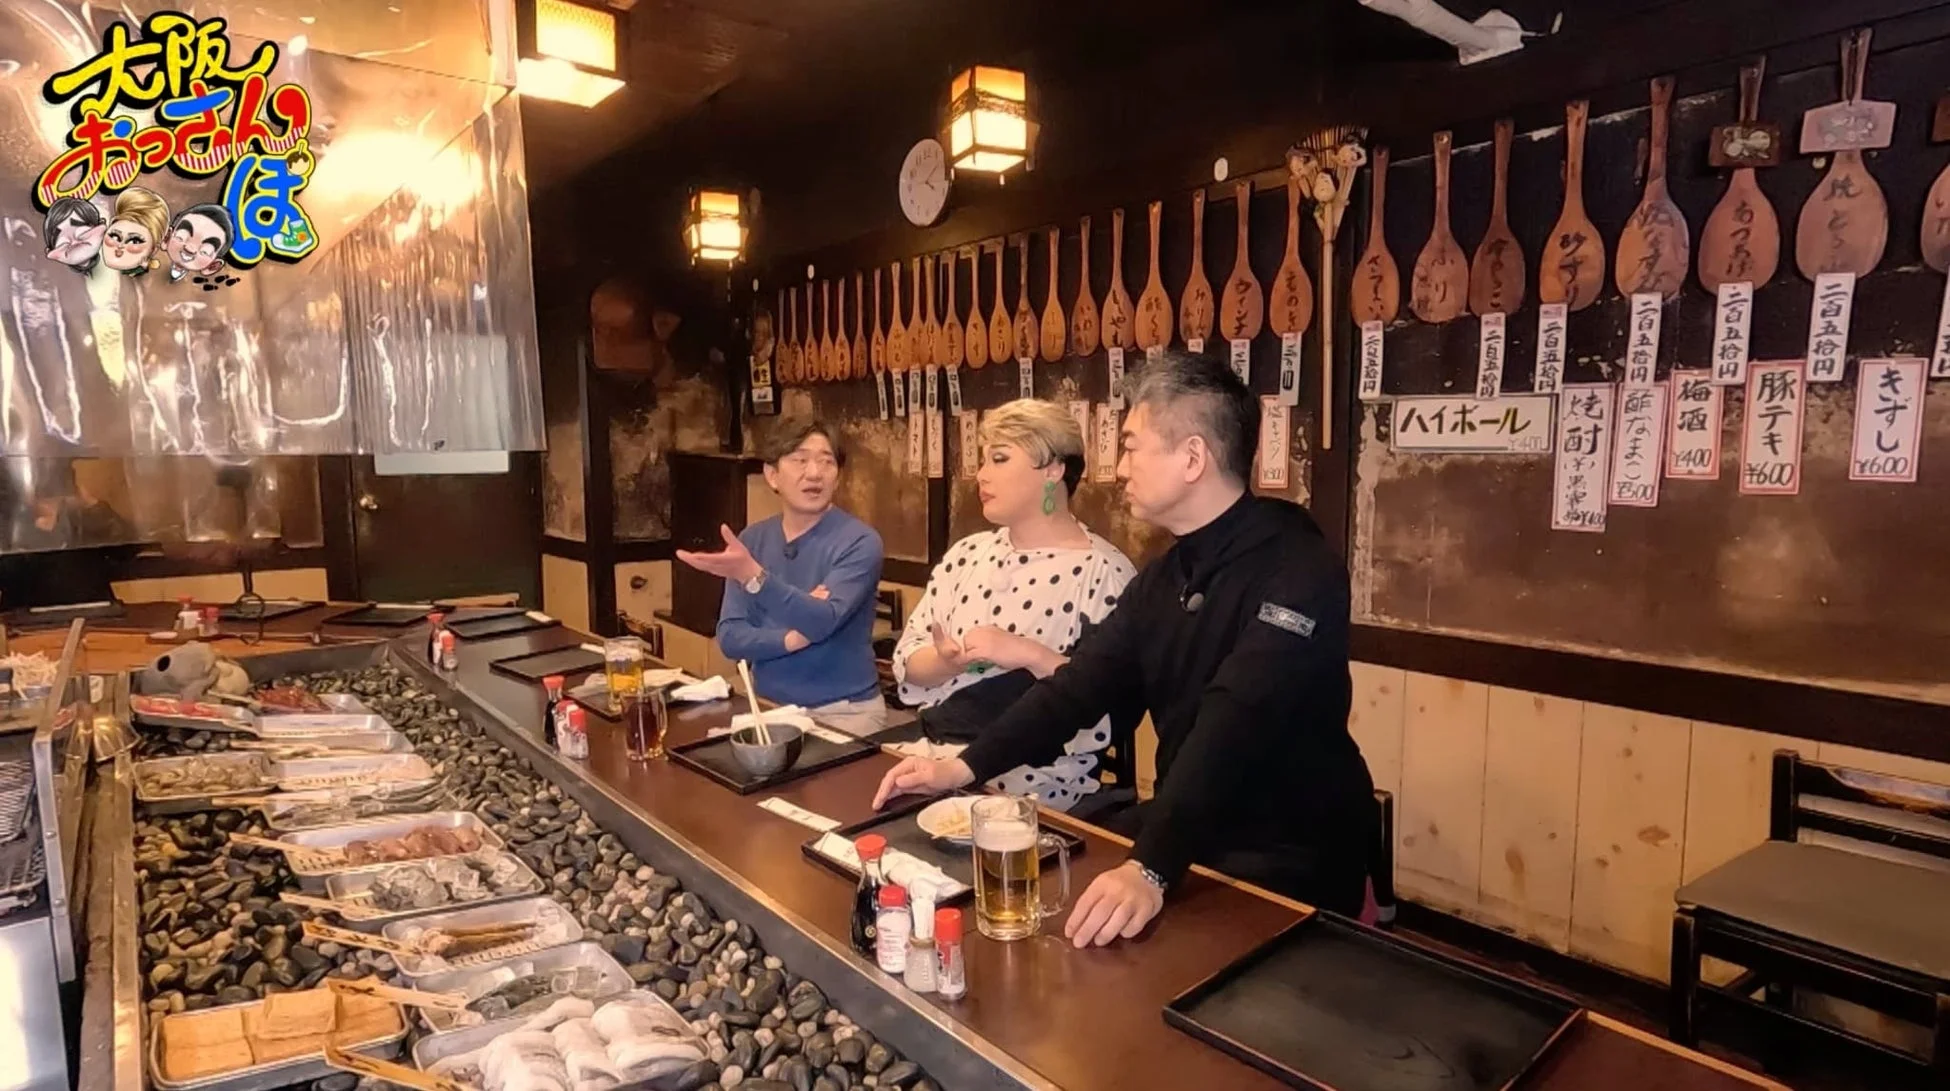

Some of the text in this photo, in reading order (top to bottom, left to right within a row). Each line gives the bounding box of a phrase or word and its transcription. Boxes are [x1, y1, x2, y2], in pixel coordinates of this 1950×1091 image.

[1399, 404, 1532, 436] ハイボール
[1677, 378, 1713, 433] 梅酒
[1756, 369, 1797, 456] 豚テキ
[1873, 368, 1913, 454] きずし
[1744, 462, 1795, 486] ¥600
[1855, 456, 1908, 476] ¥600
